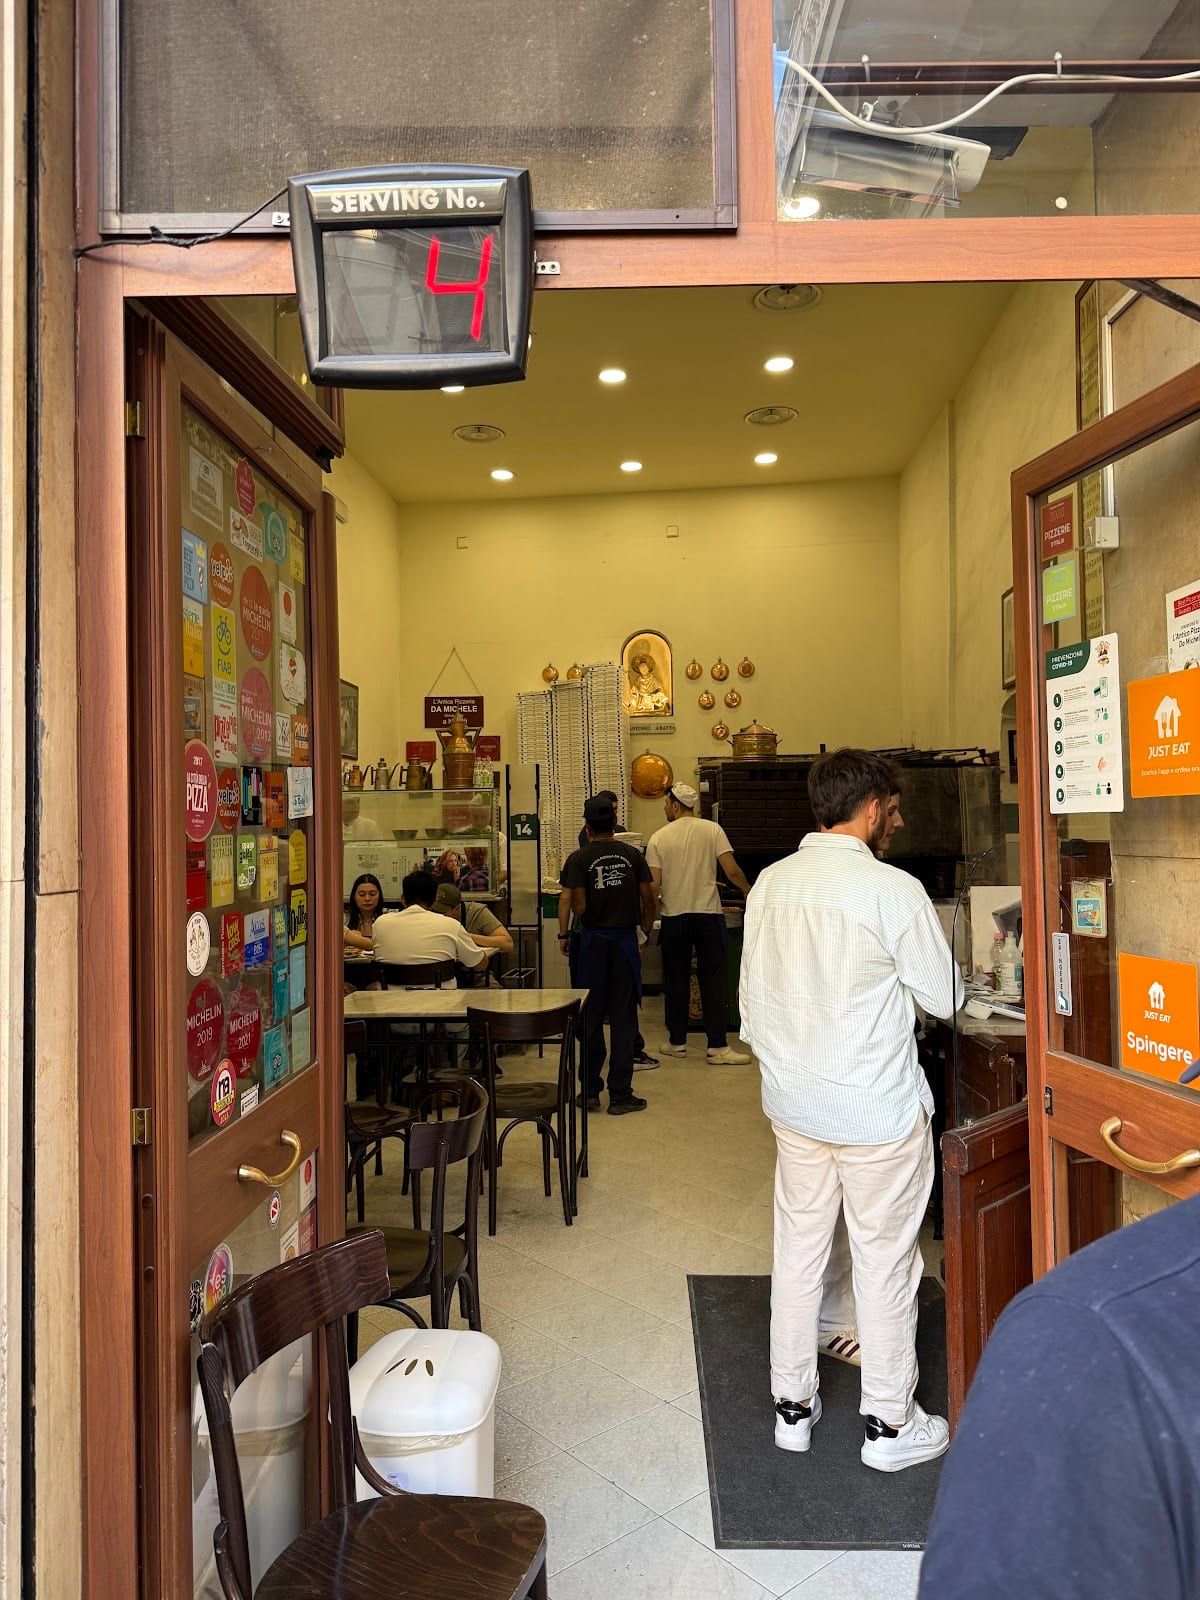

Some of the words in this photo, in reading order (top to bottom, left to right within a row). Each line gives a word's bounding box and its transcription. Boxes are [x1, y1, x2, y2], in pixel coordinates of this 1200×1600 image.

[330, 189, 439, 213] SERVING
[446, 187, 486, 209] No.
[426, 235, 494, 341] 4
[1044, 522, 1071, 542] PIZZERIE
[1046, 587, 1073, 604] PIZZERIE
[242, 606, 271, 632] MICHELIN
[1051, 650, 1084, 664] PREVENZIONE
[217, 659, 232, 675] FIAB
[241, 706, 272, 728] MICHELIN
[430, 705, 443, 713] DA
[443, 705, 478, 713] MICHELE
[256, 727, 272, 742] 2012
[1147, 744, 1171, 760] JUST
[1171, 741, 1191, 756] EAT
[186, 783, 209, 812] PIZZA
[514, 823, 533, 837] 14
[212, 836, 233, 848] OSTERIE
[186, 1003, 222, 1032] MICHELIN
[229, 1009, 259, 1035] MICHELIN
[1143, 1010, 1159, 1022] JUST
[1159, 1012, 1171, 1024] EAT
[196, 1026, 213, 1047] 2019
[238, 1032, 251, 1050] 2021
[1127, 1030, 1194, 1065] Spingere
